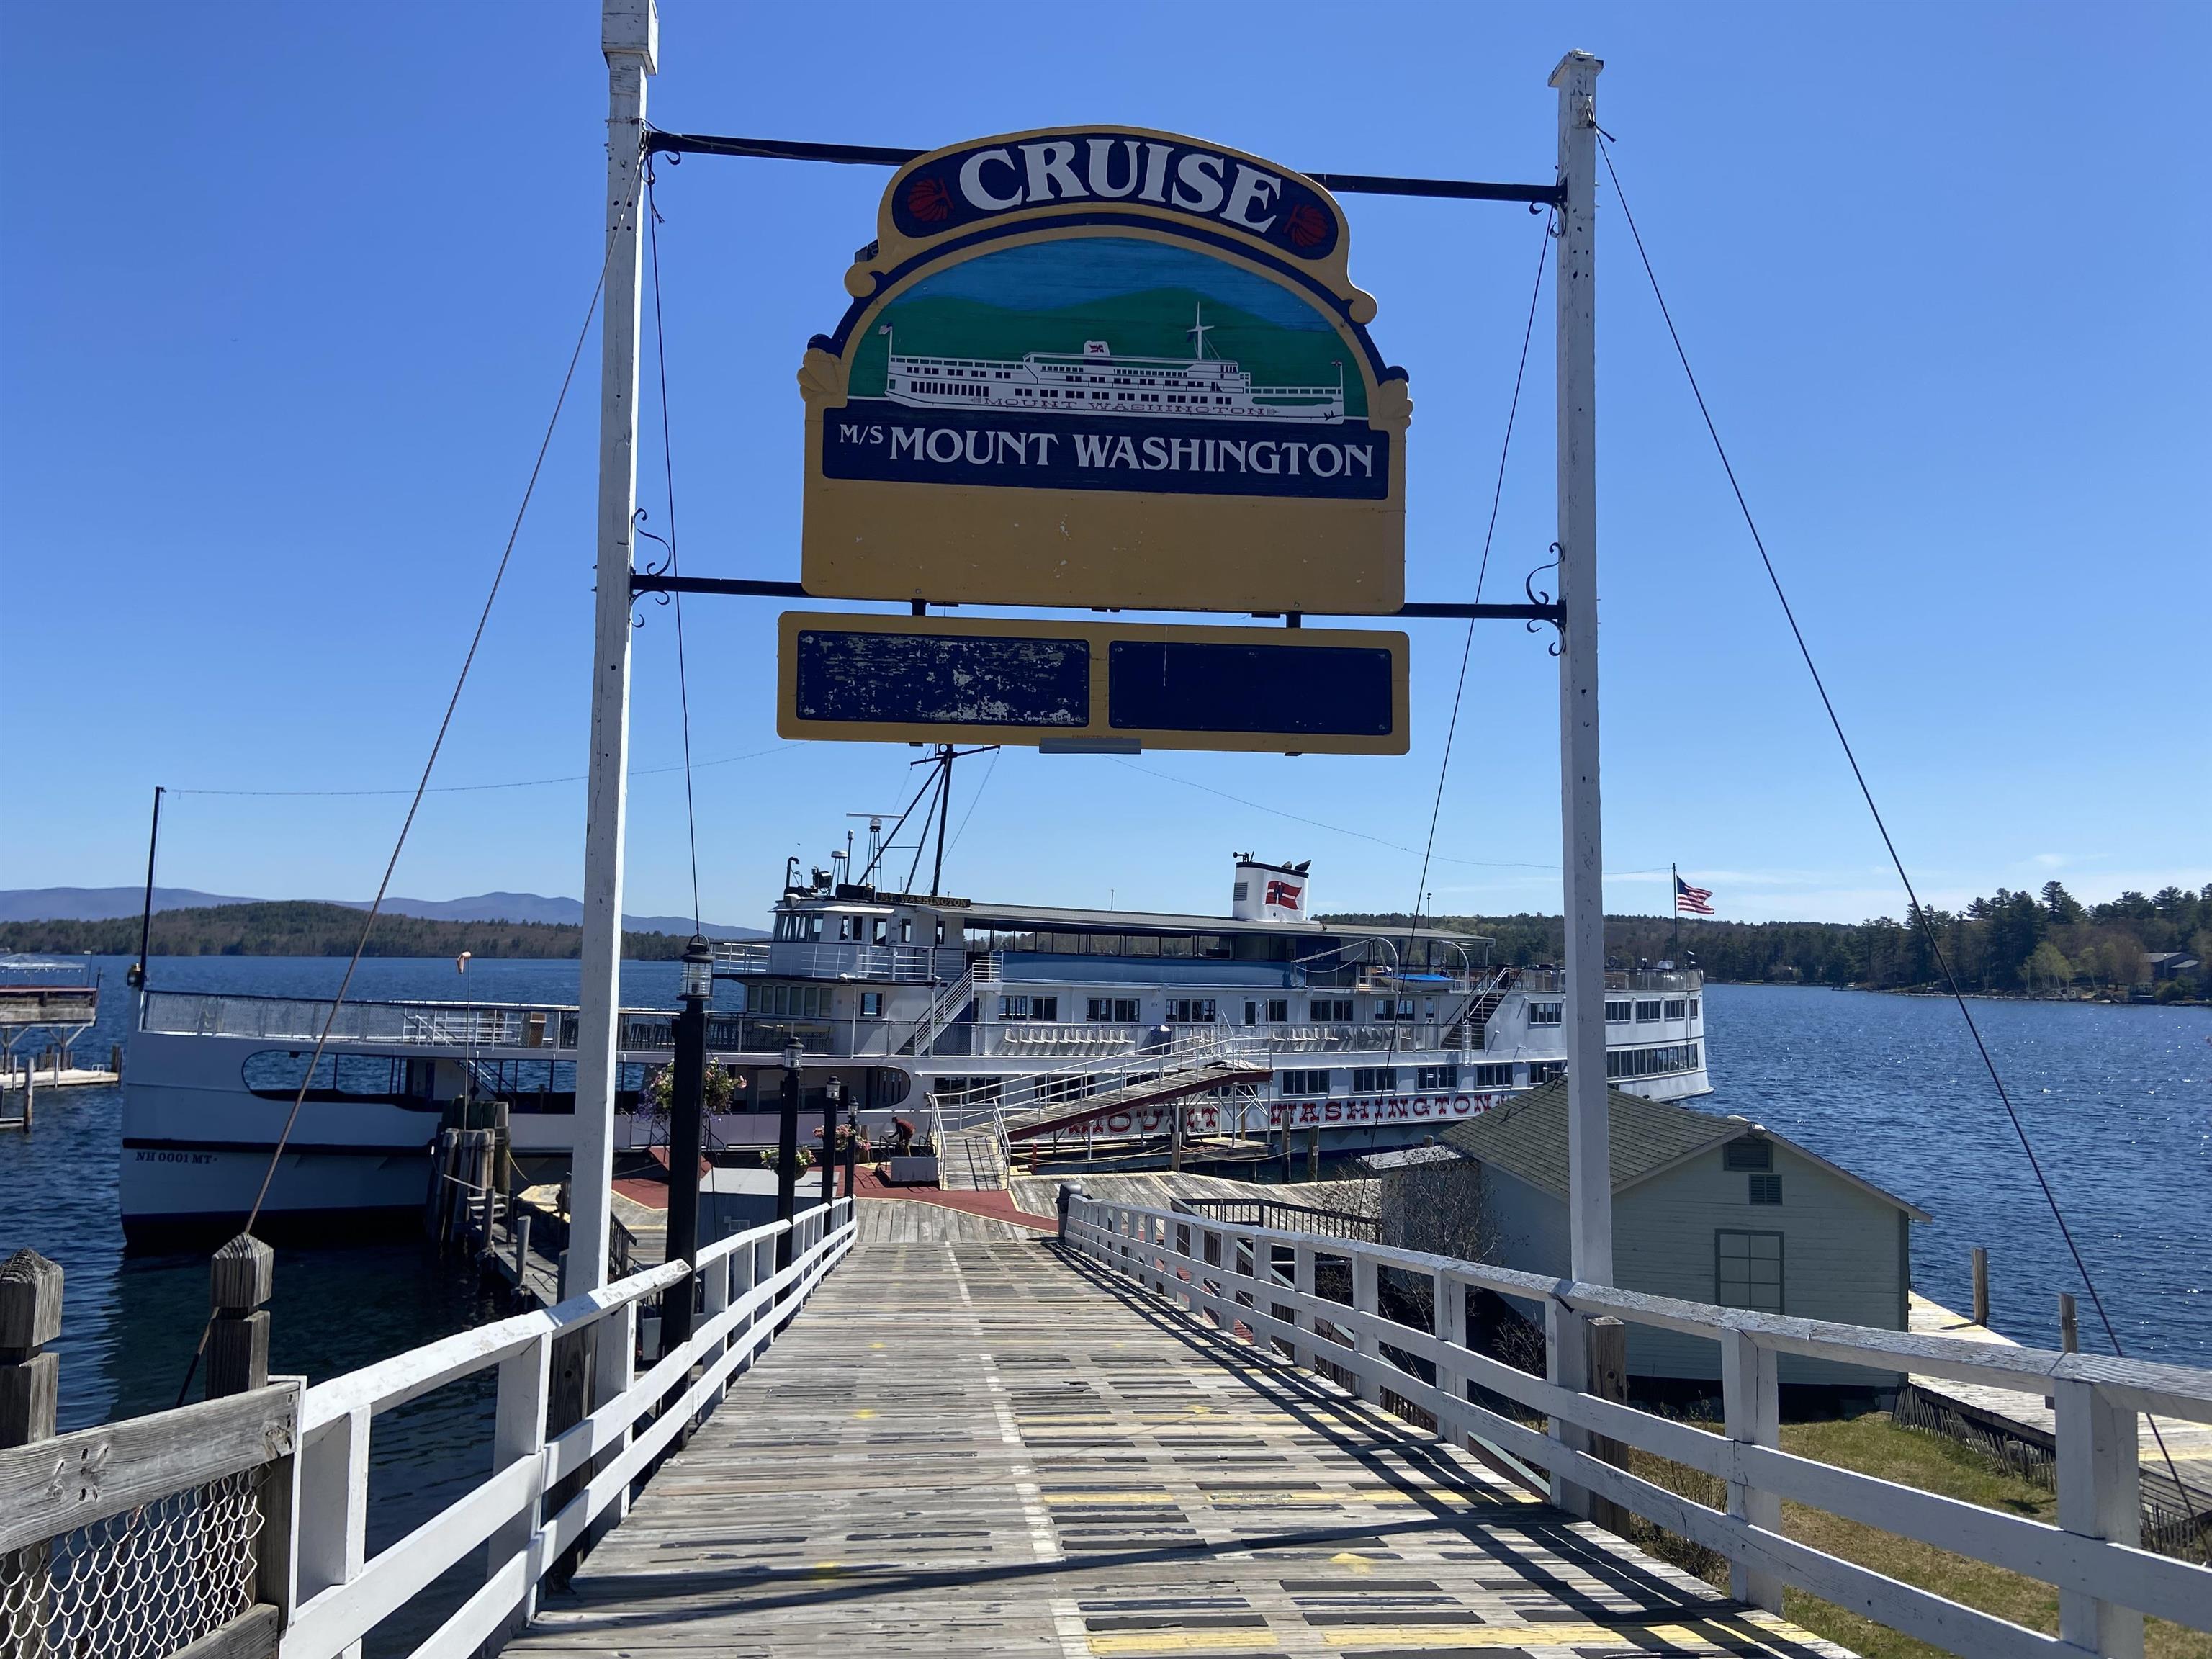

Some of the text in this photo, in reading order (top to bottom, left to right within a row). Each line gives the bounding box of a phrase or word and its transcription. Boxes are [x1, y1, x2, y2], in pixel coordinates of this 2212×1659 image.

[959, 138, 1282, 233] CRUISE
[984, 397, 1077, 409] MOUNT
[839, 423, 1373, 477] M/S MOUNT WASHINGTON
[900, 895, 968, 907] WASHINGTON
[1271, 1094, 1492, 1125] WASHINGTON
[135, 1151, 156, 1161] NH
[158, 1153, 189, 1163] 0001
